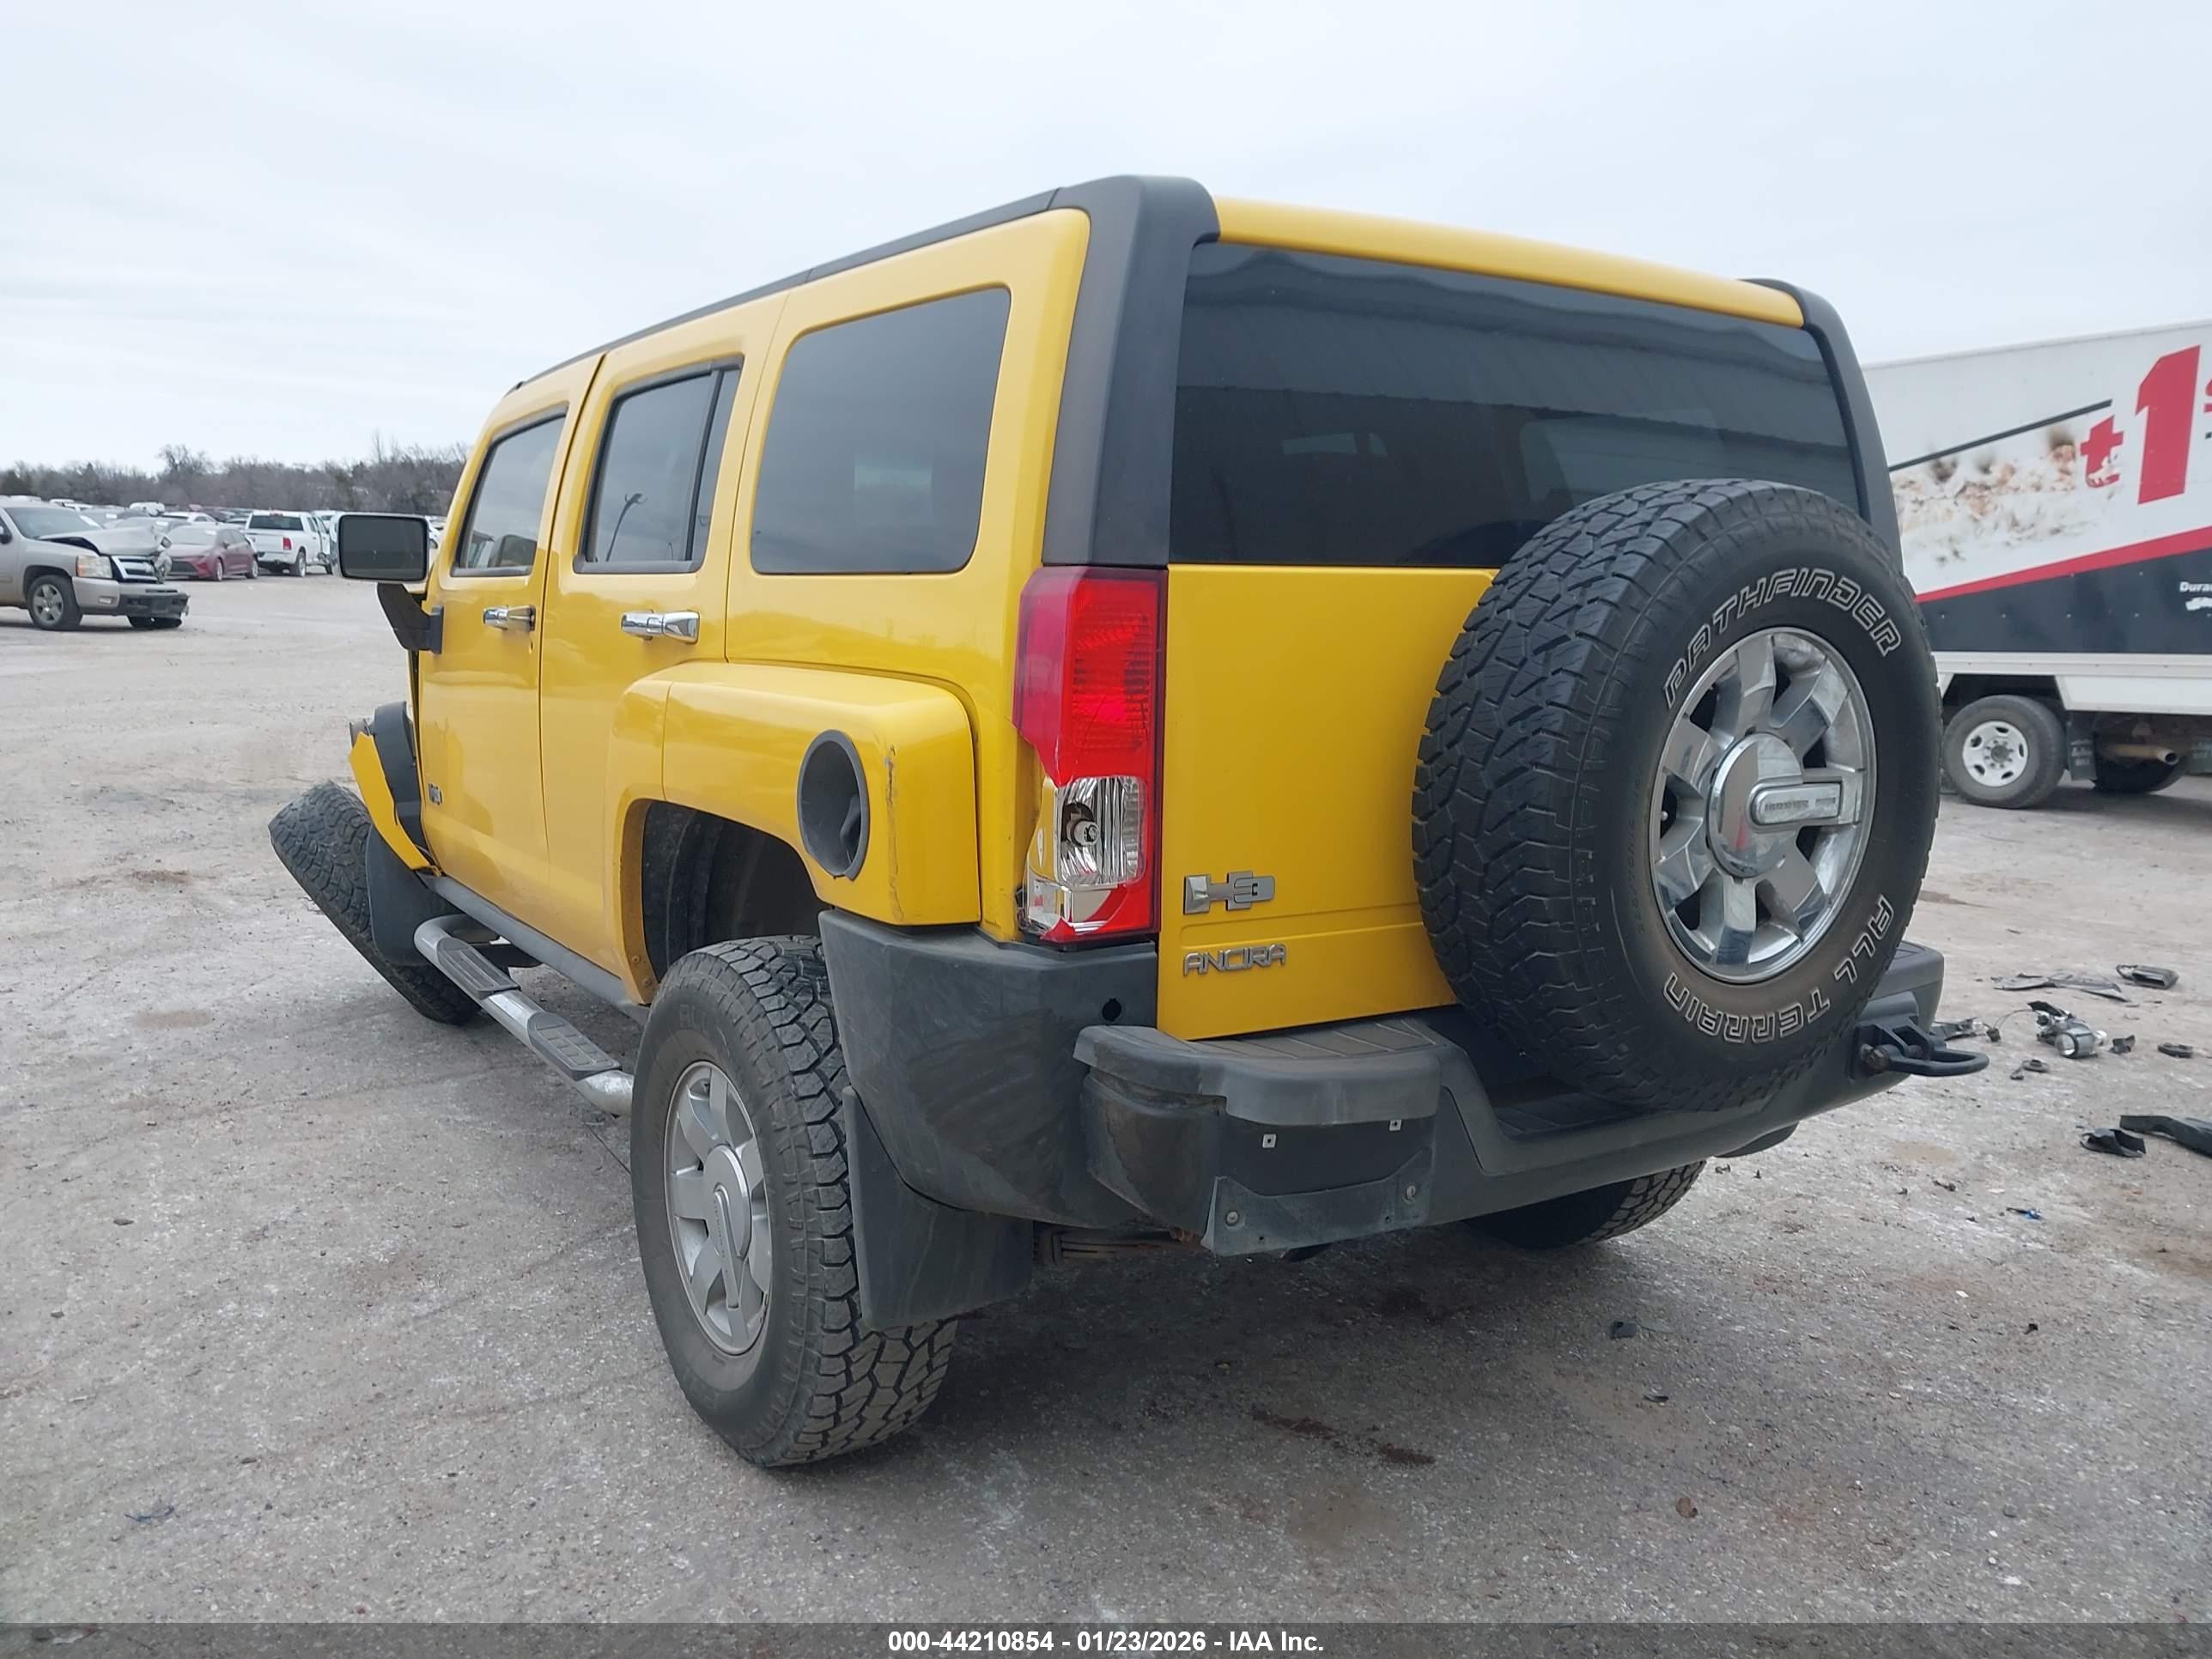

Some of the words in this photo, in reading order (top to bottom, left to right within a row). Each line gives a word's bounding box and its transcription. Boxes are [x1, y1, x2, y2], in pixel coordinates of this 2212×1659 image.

[1663, 568, 1901, 708] PATHFINDER
[1183, 871, 1275, 915] H3
[1183, 944, 1287, 977] ANCIRA
[1833, 894, 1894, 984] ALL
[1663, 971, 1831, 1044] TERRAIN
